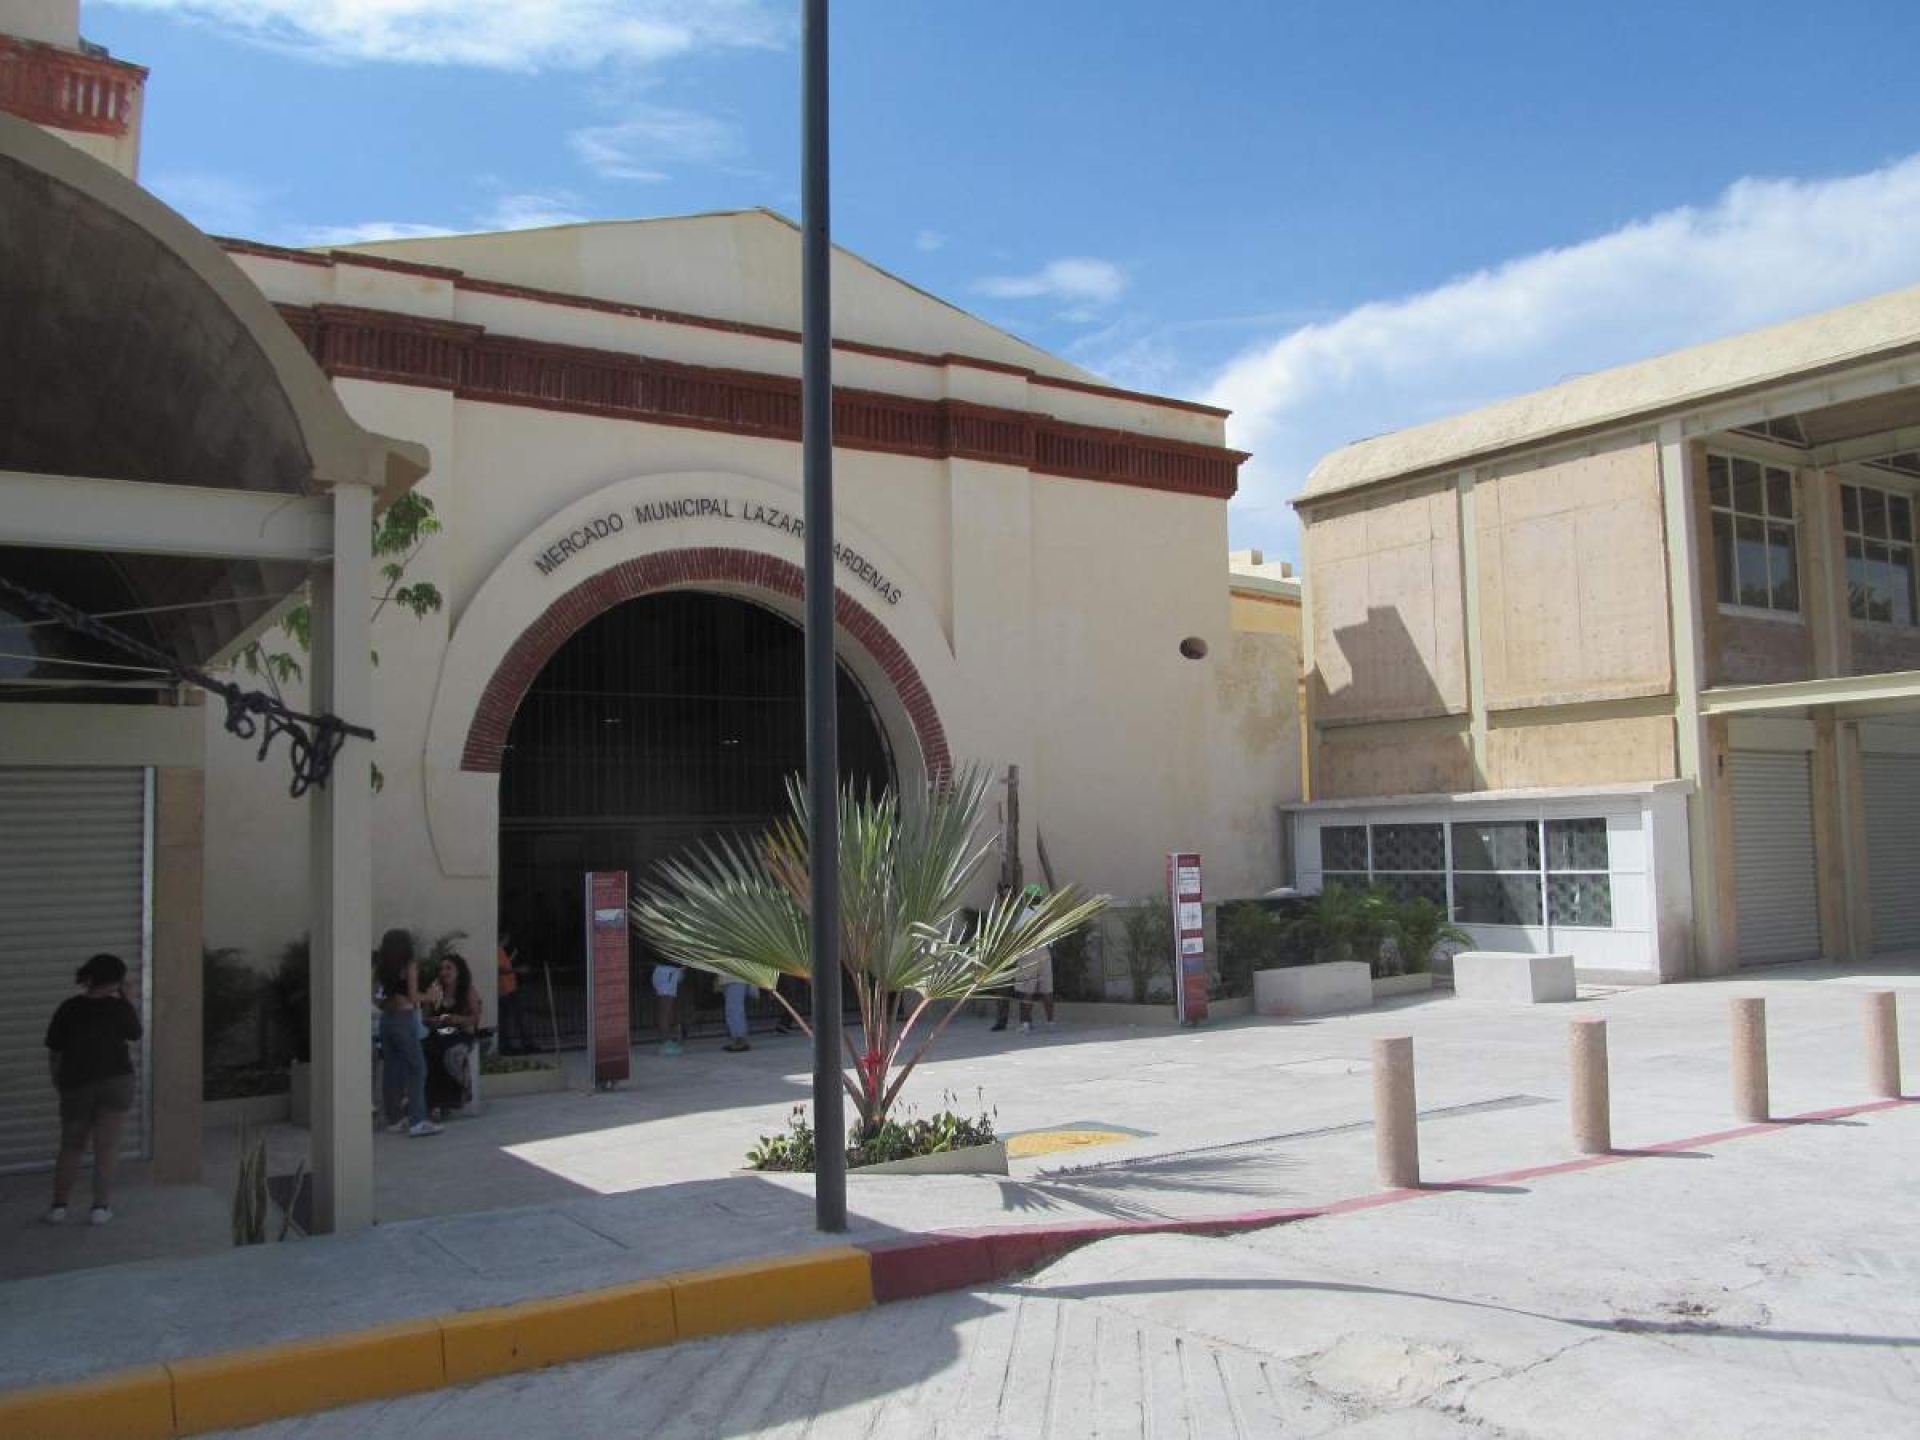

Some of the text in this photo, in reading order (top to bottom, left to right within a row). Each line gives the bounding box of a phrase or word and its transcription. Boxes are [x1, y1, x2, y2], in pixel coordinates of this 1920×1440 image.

[534, 498, 902, 605] MERCADO MUNICIPAL LAZAR ARDENAS
